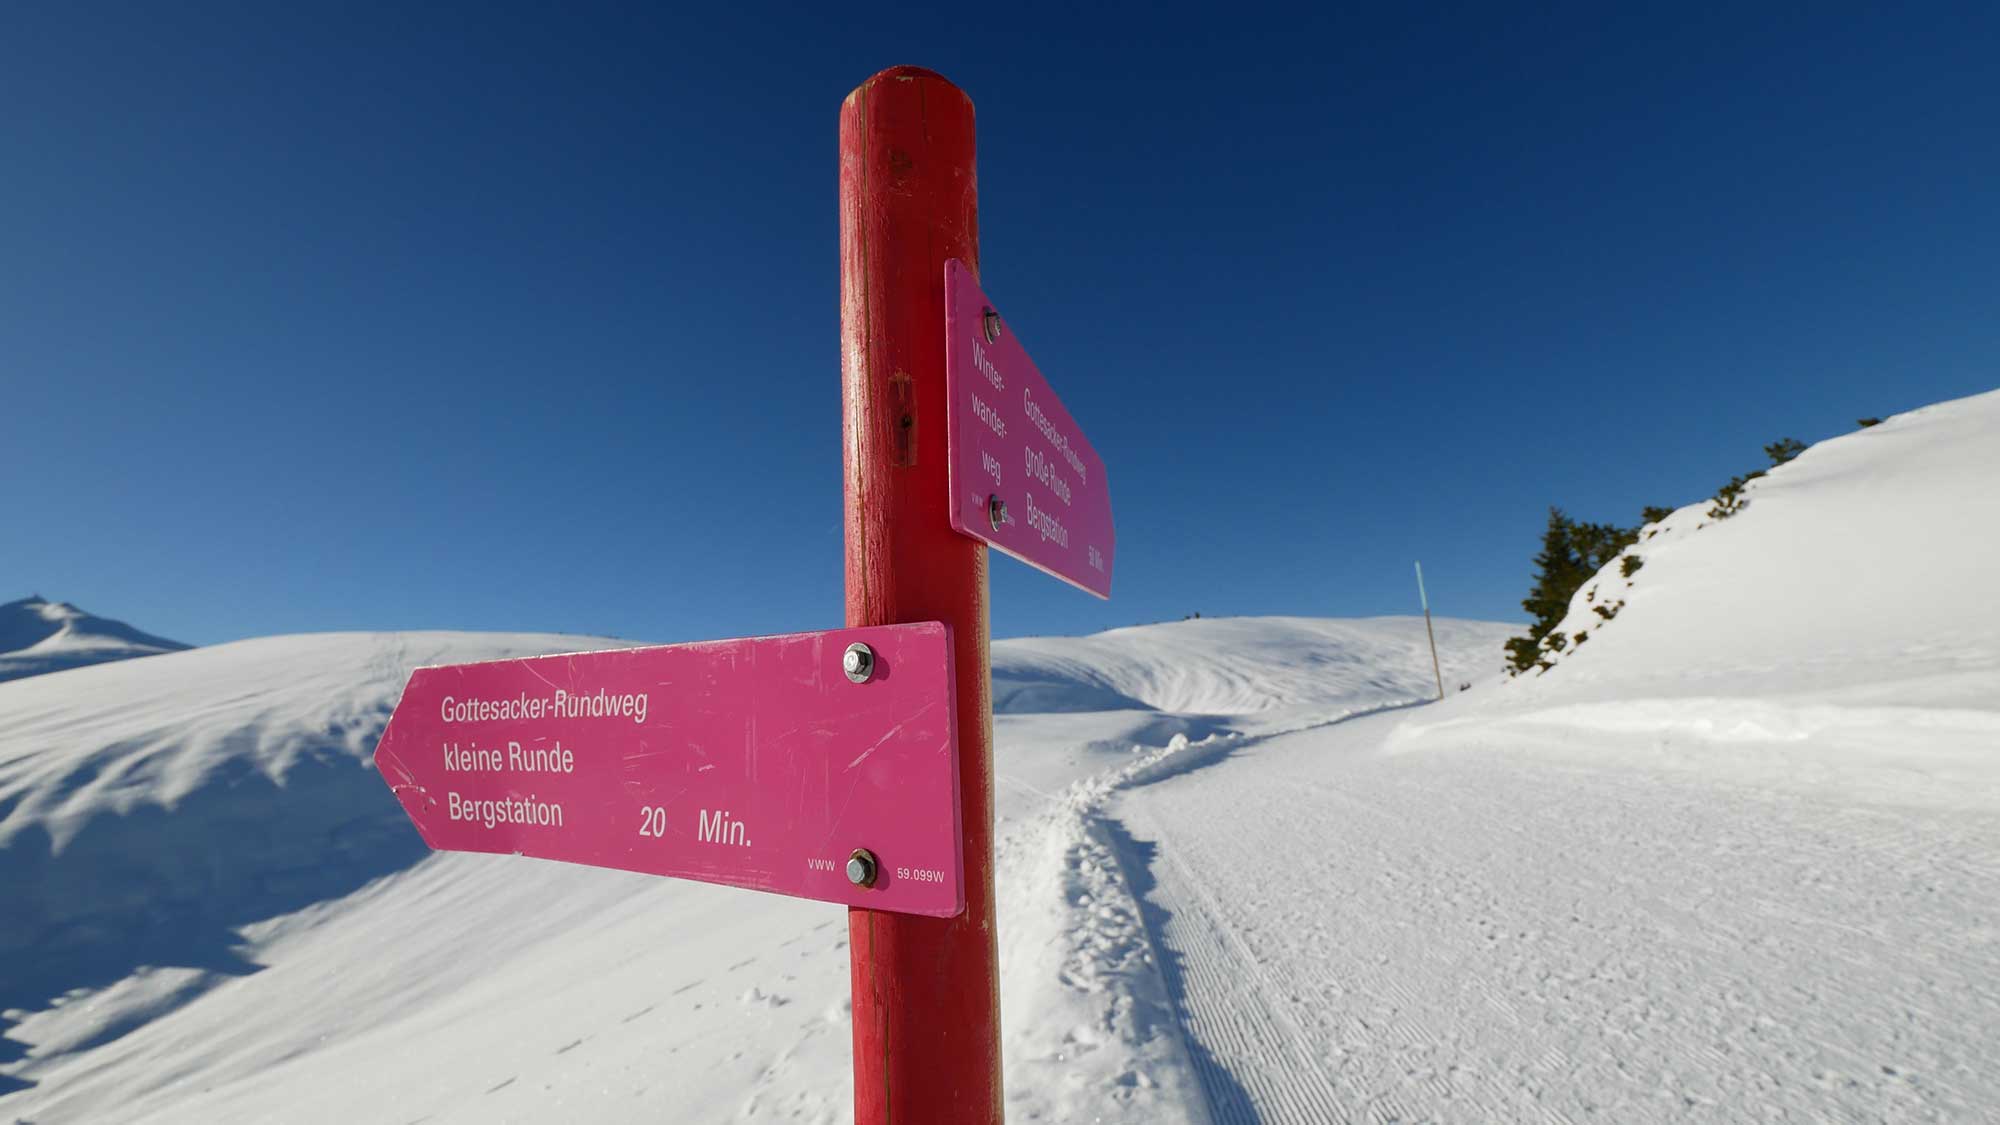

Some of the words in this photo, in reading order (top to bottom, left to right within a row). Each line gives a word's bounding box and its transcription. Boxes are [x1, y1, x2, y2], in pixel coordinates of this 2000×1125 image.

[972, 337, 1005, 391] Winter-
[971, 391, 1007, 438] wander-
[1023, 387, 1087, 486] Gottesacker-Rundweg
[982, 450, 1001, 486] weg
[1024, 445, 1050, 487] große
[1050, 463, 1071, 507] Runde
[1026, 492, 1068, 549] Bergstation
[440, 688, 648, 723] Gottesacker-Rundweg
[443, 743, 503, 772] kleine
[508, 741, 574, 774] Runde
[448, 792, 563, 829] Bergstation
[638, 806, 667, 838] 20
[697, 809, 752, 847] Min.
[897, 867, 945, 883] 59.099W
